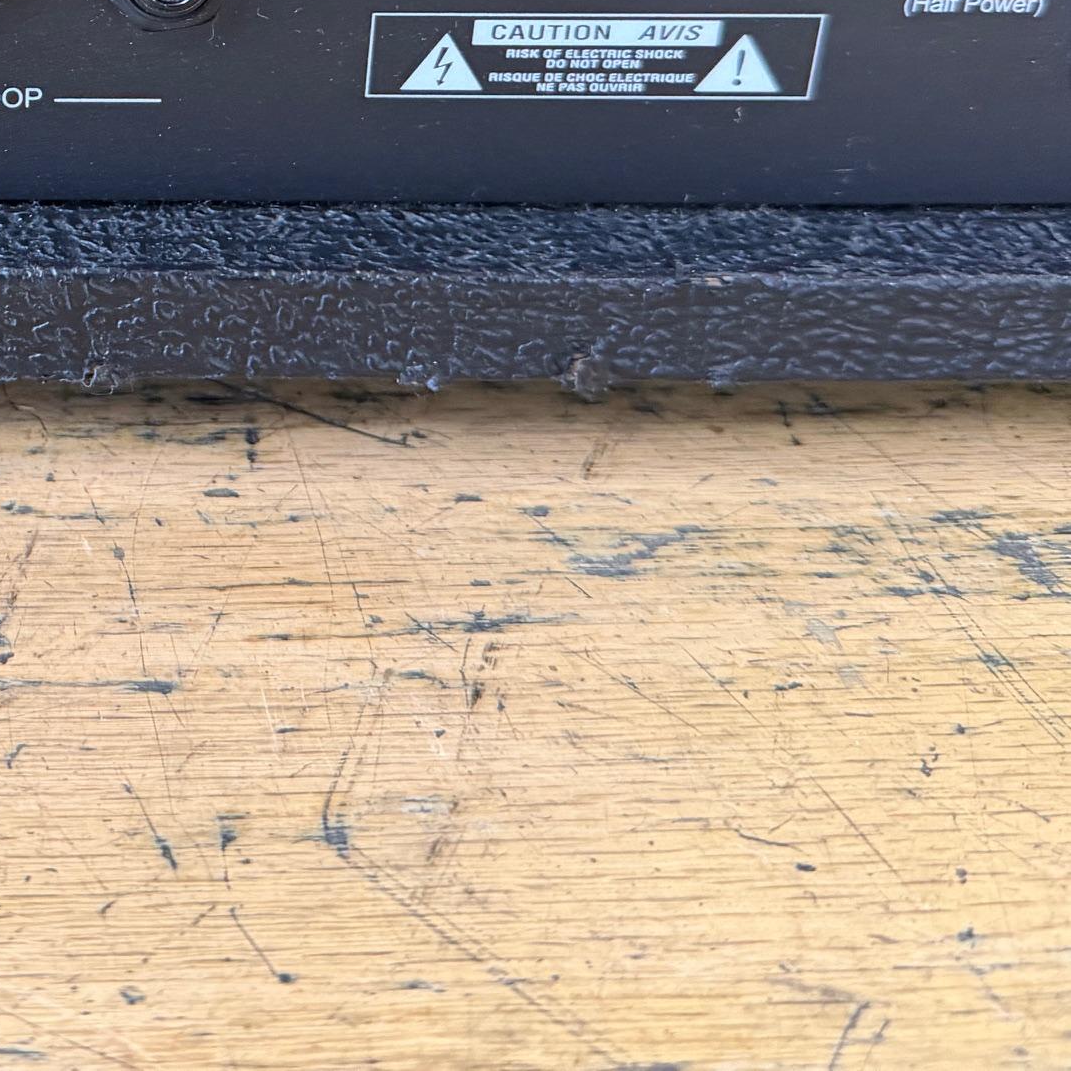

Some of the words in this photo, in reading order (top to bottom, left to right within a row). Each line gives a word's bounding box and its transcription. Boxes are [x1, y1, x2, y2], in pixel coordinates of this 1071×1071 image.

[490, 23, 611, 41] CAUTION
[638, 24, 704, 41] AVIS
[505, 48, 540, 59] RISK
[542, 48, 563, 59] OF
[564, 49, 633, 60] ELECTRIC
[634, 49, 685, 60] SHOCK
[545, 59, 567, 69] DO
[569, 59, 600, 69] NOT
[602, 59, 643, 69] OPEN
[488, 72, 541, 83] RISQUE
[543, 72, 563, 83] DE
[565, 73, 606, 83] CHOC
[607, 73, 696, 84] ELECTRIQUE
[535, 82, 555, 92] NE
[557, 82, 586, 92] PAS
[588, 82, 645, 93] OUVRIR
